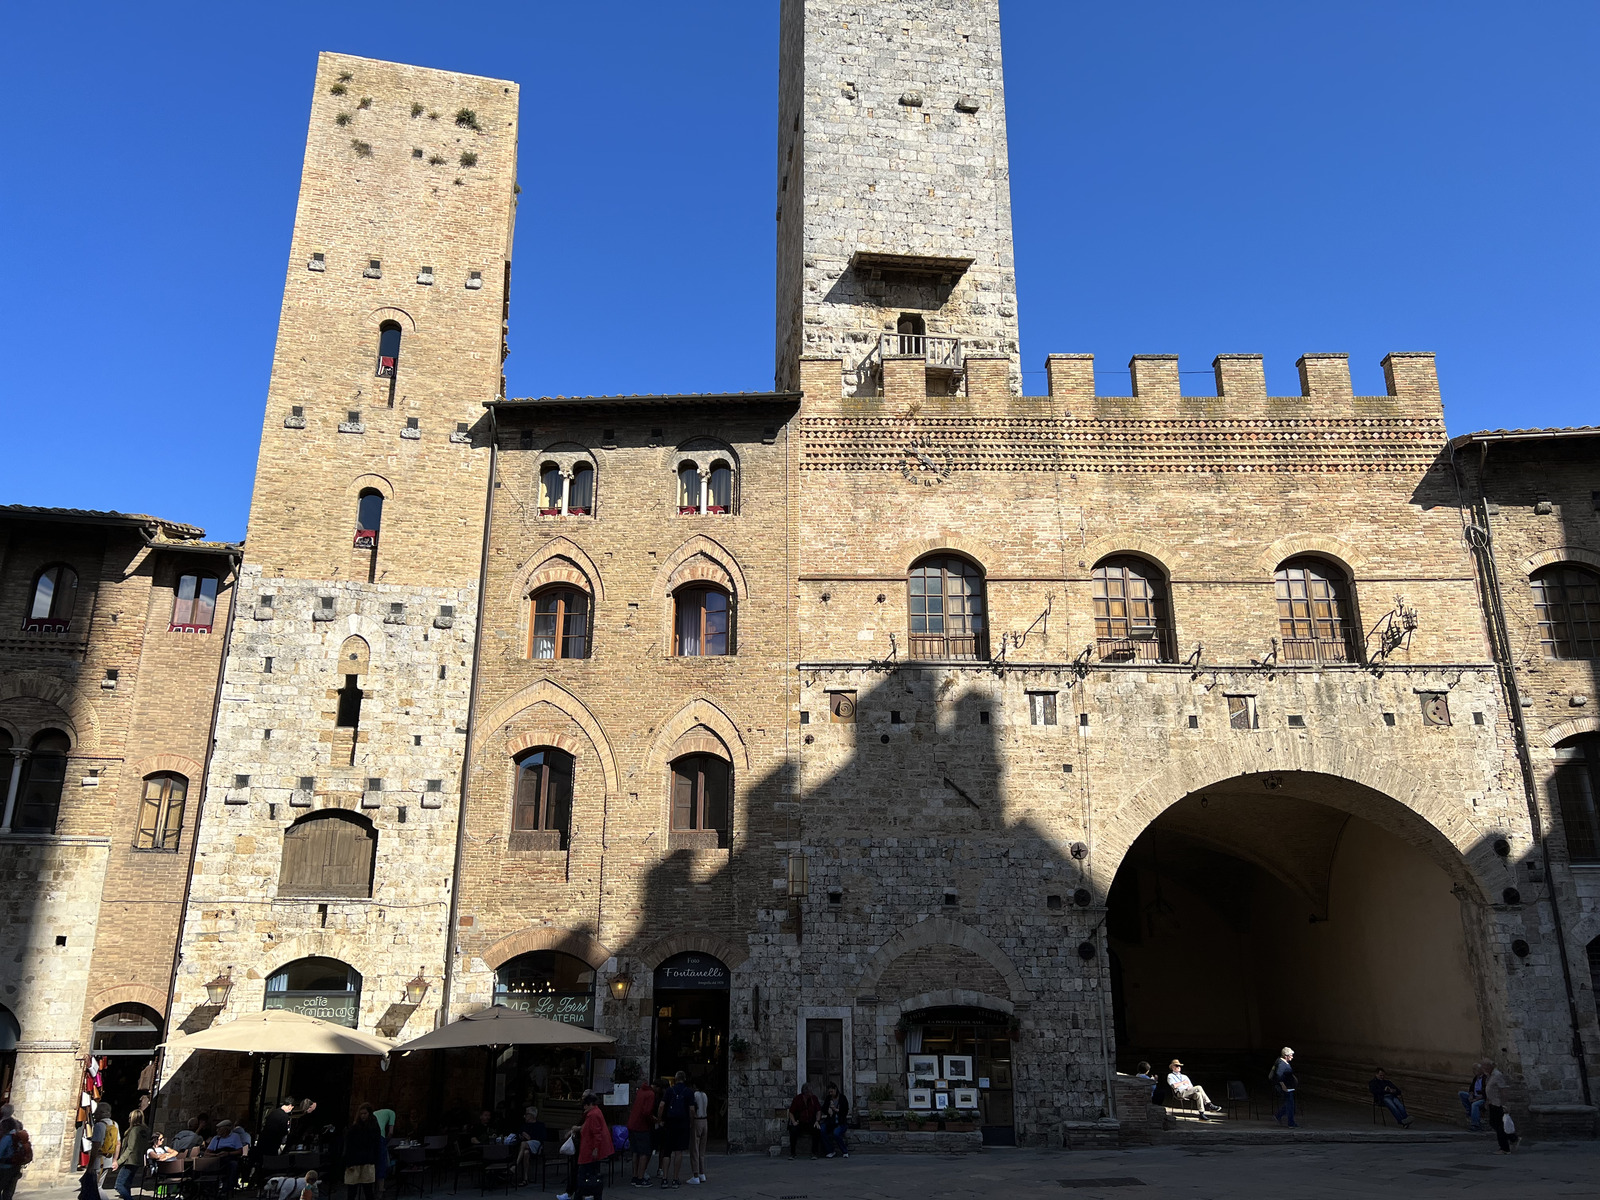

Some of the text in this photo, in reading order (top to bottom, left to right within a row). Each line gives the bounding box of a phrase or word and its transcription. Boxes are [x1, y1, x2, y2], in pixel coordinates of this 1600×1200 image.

[686, 957, 700, 965] Foto
[661, 967, 725, 978] Fontanelli
[535, 996, 555, 1013] Le
